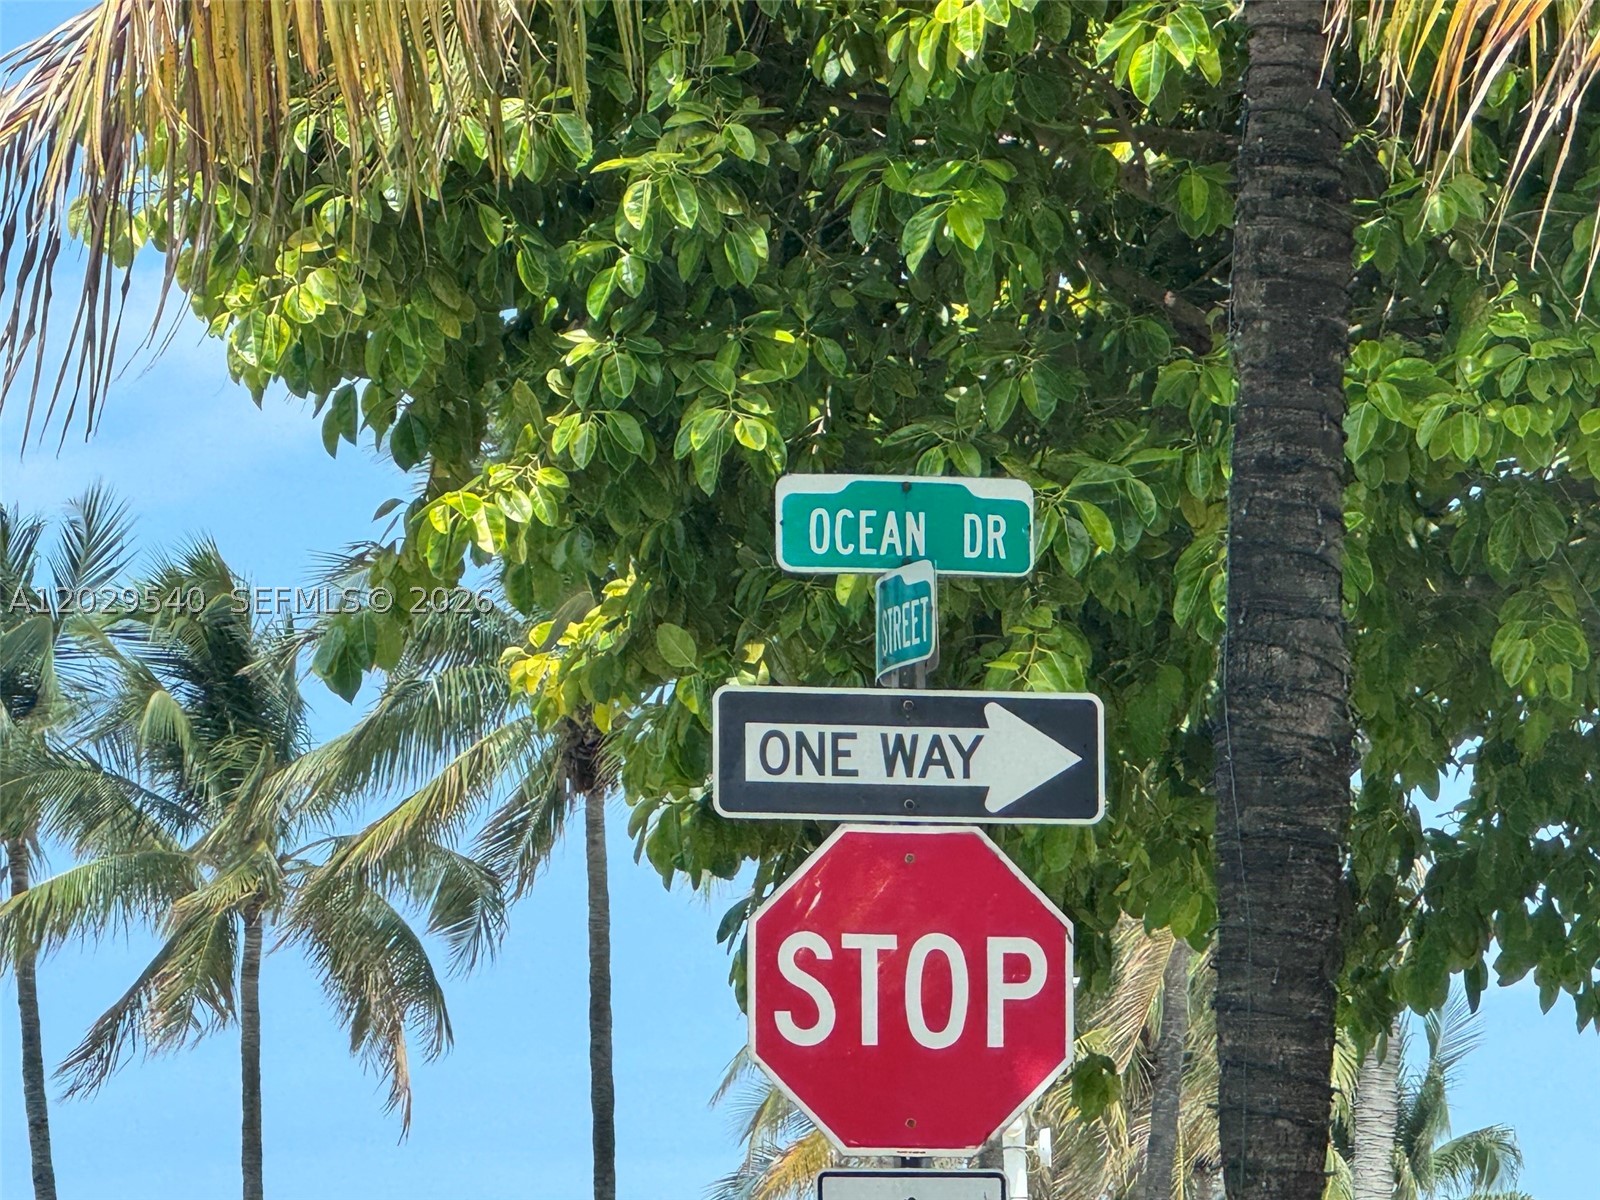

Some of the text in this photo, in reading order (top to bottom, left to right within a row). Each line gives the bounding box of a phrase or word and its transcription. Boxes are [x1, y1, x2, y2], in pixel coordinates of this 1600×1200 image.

[809, 507, 1007, 560] OCEAN DR
[881, 596, 929, 657] STREET
[758, 729, 985, 780] ONE WAY
[773, 930, 1048, 1050] STOP
